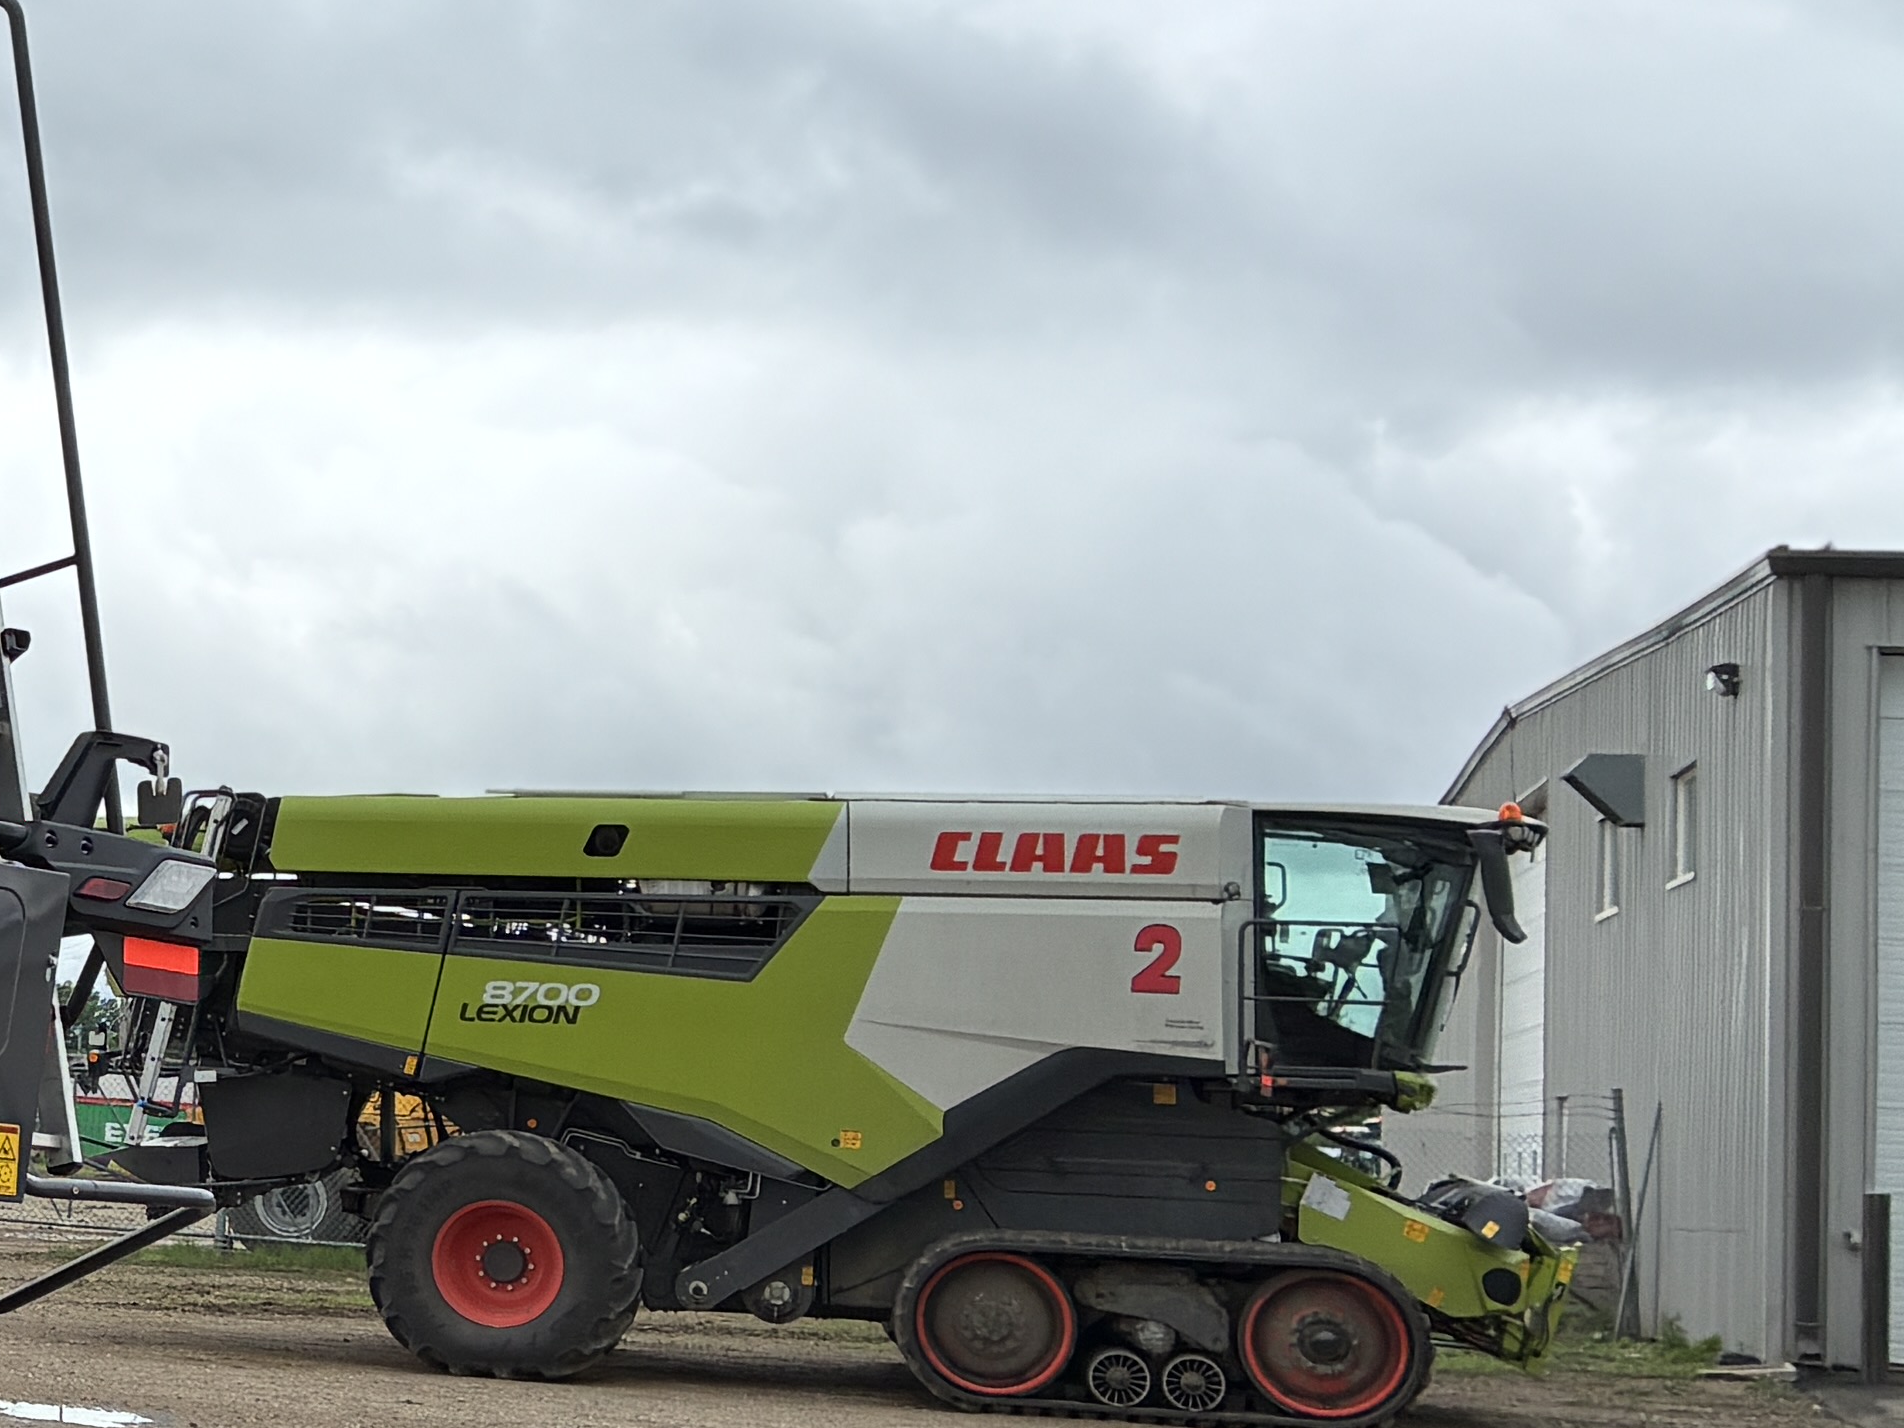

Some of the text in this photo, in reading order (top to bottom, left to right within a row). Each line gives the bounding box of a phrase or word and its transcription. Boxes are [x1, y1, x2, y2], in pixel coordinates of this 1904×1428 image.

[930, 831, 1181, 875] CLAAS
[1131, 924, 1182, 995] 2
[482, 980, 601, 1007] 8700
[459, 1002, 581, 1025] LEXION
